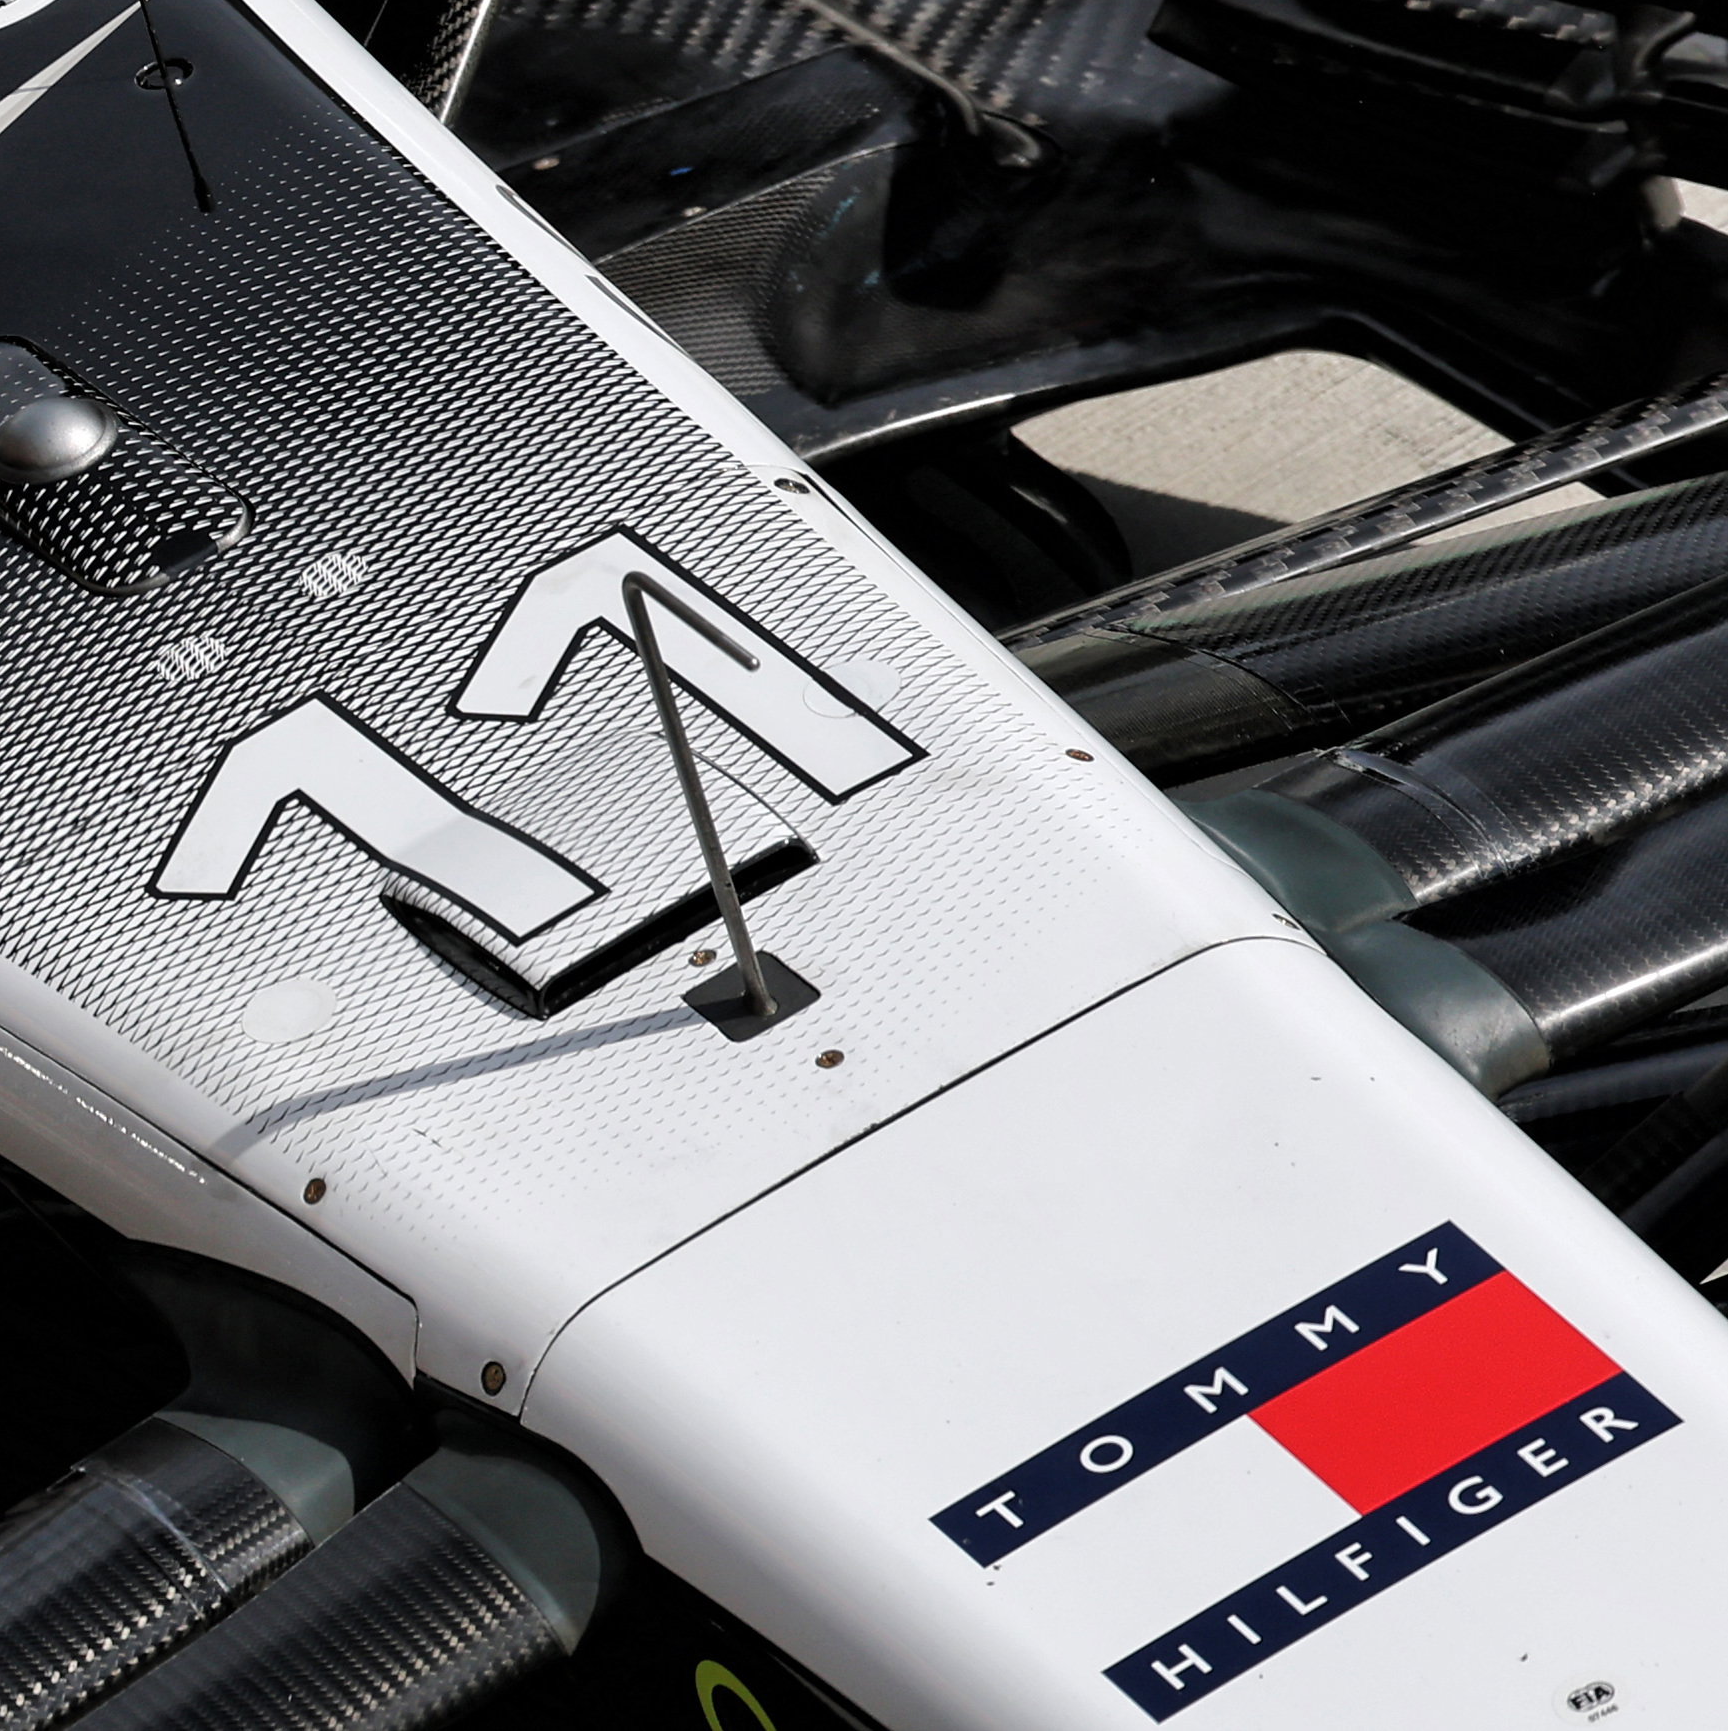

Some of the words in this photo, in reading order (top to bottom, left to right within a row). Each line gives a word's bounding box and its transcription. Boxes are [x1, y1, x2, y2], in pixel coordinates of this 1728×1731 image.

[146, 523, 929, 946] 11
[975, 1247, 1451, 1531] TOMMY
[1149, 1404, 1639, 1691] HILFIGER
[1569, 1684, 1612, 1711] FIA
